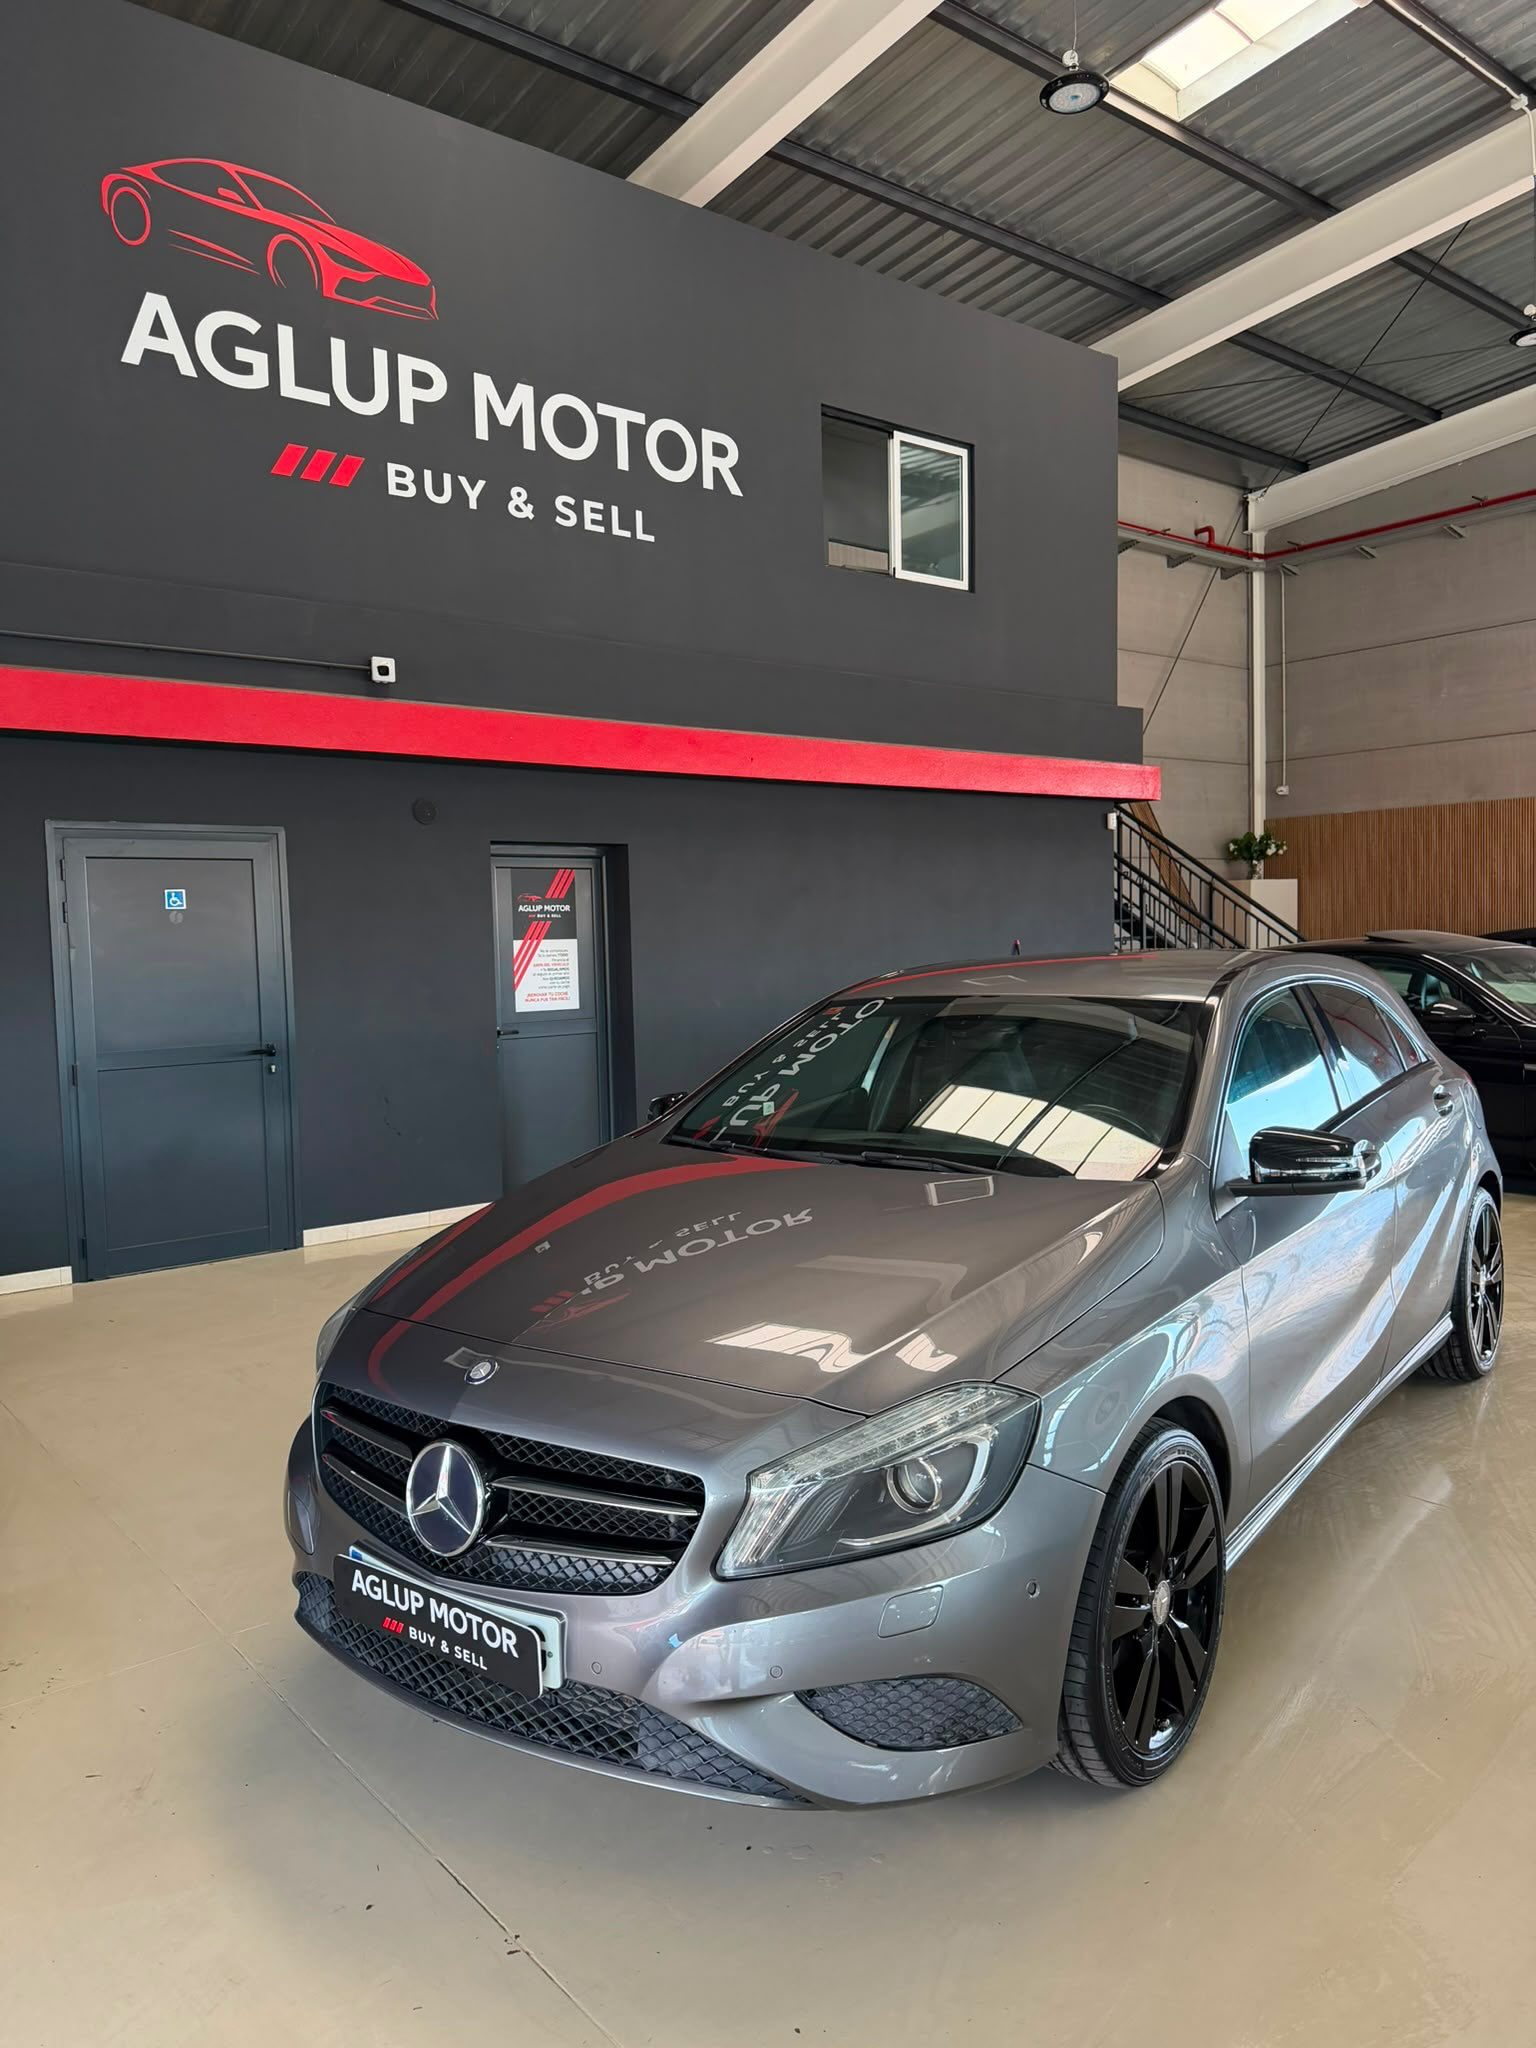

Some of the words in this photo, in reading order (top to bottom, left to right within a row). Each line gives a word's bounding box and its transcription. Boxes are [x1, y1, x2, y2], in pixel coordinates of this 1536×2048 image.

[120, 291, 448, 426] AGLUP
[472, 371, 744, 497] MOTOR
[385, 461, 487, 511] BUY
[506, 485, 536, 521] &
[554, 494, 656, 543] SELL
[518, 904, 543, 912] AGLUP
[543, 904, 571, 912] MOTOR
[351, 1569, 424, 1616] AGLUP
[429, 1598, 519, 1658] MOTOR
[409, 1626, 436, 1647] BUY
[440, 1640, 449, 1654] &
[454, 1645, 488, 1671] SELL
